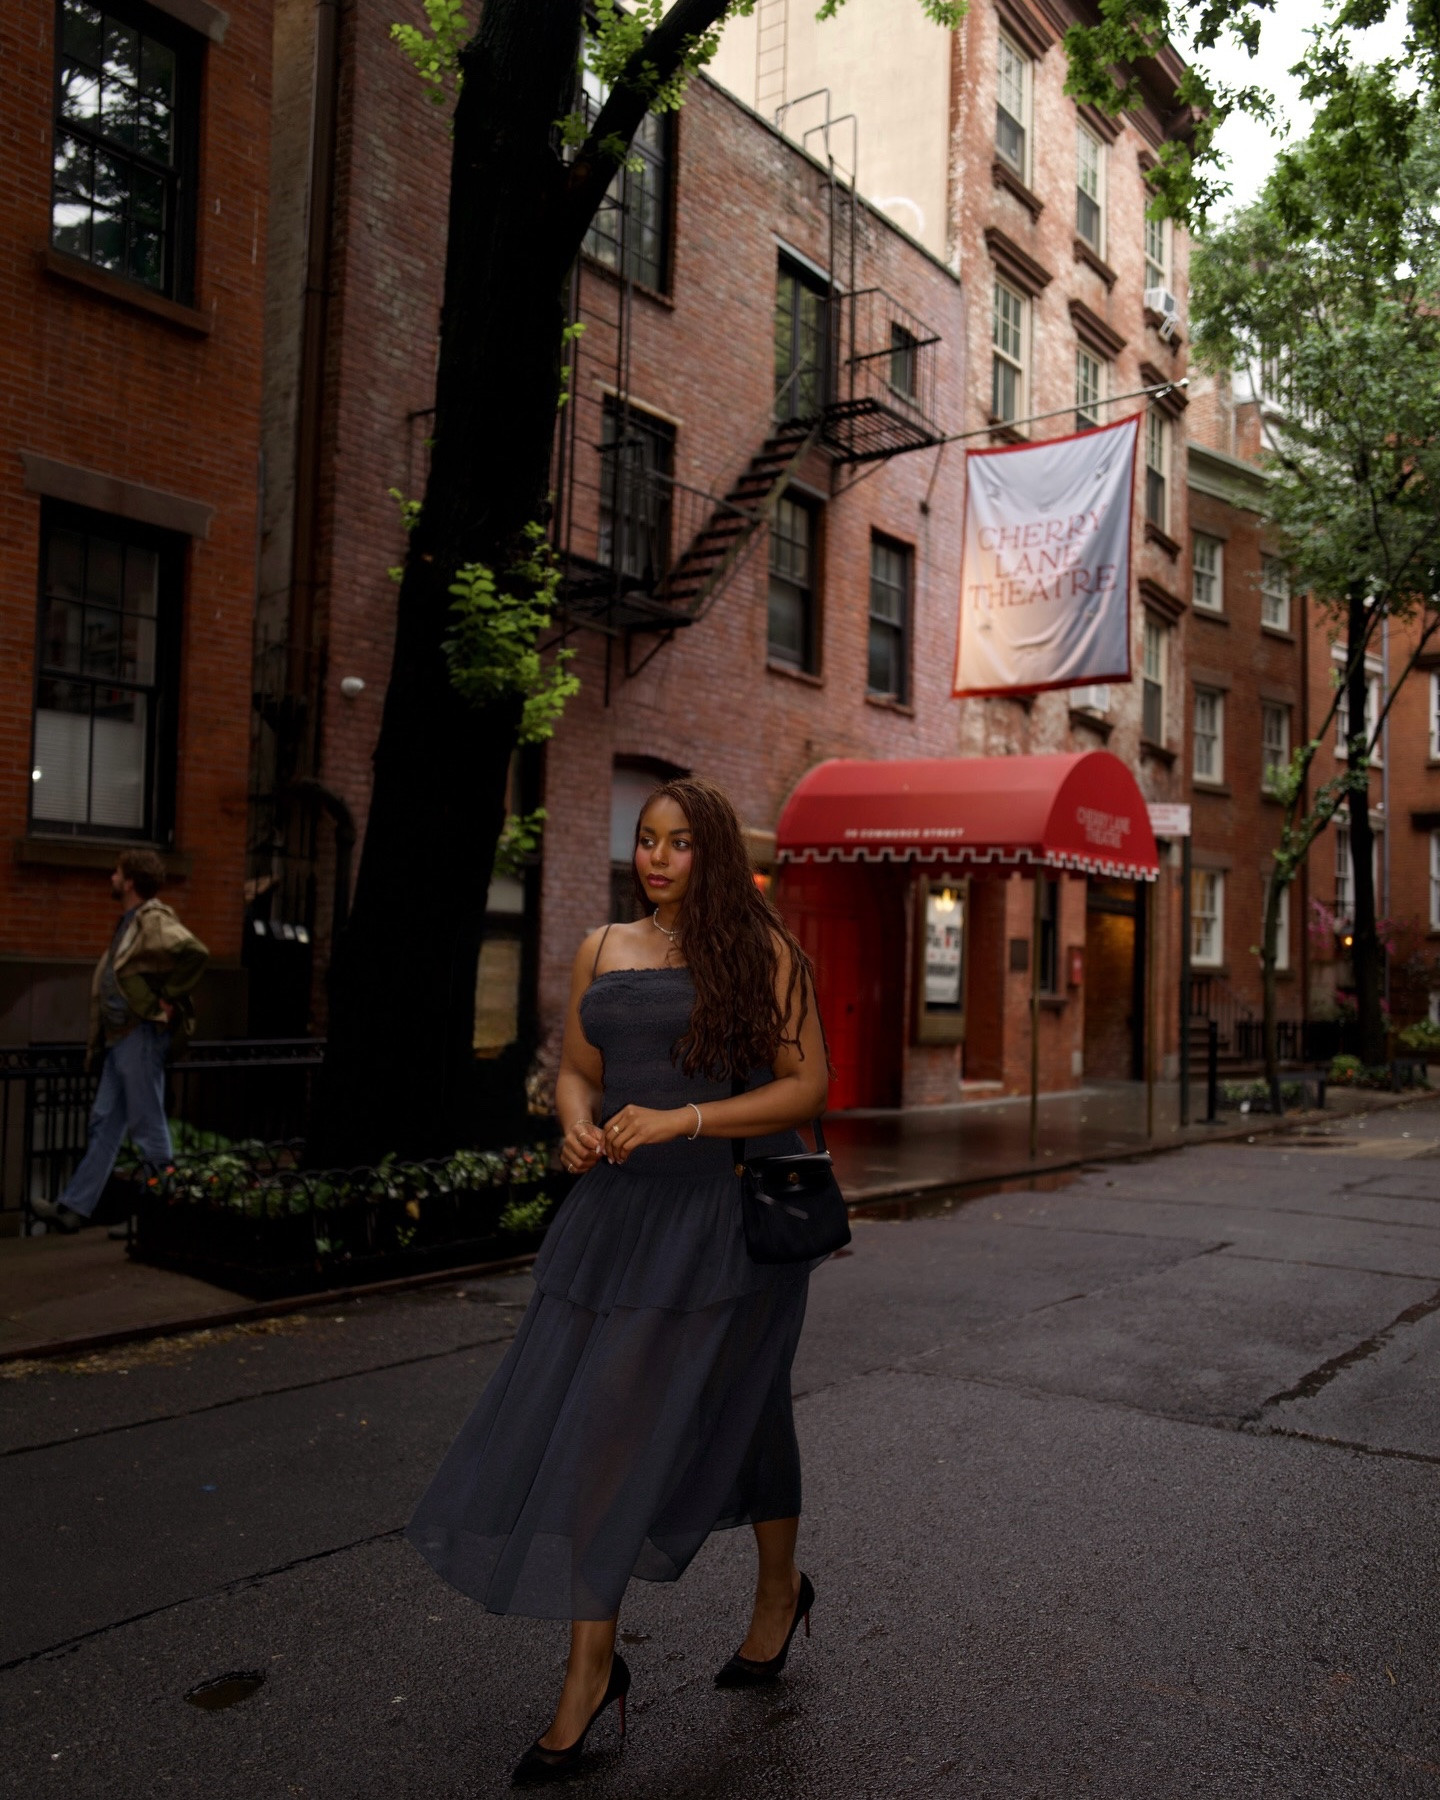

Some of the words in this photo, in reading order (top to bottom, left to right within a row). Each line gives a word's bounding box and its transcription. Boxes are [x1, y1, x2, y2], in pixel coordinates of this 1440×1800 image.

[977, 504, 1108, 551] CHERRY
[995, 542, 1083, 579] LANE
[968, 563, 1117, 610] THEATRE
[860, 828, 920, 839] COMMERCE
[922, 827, 965, 838] STREET
